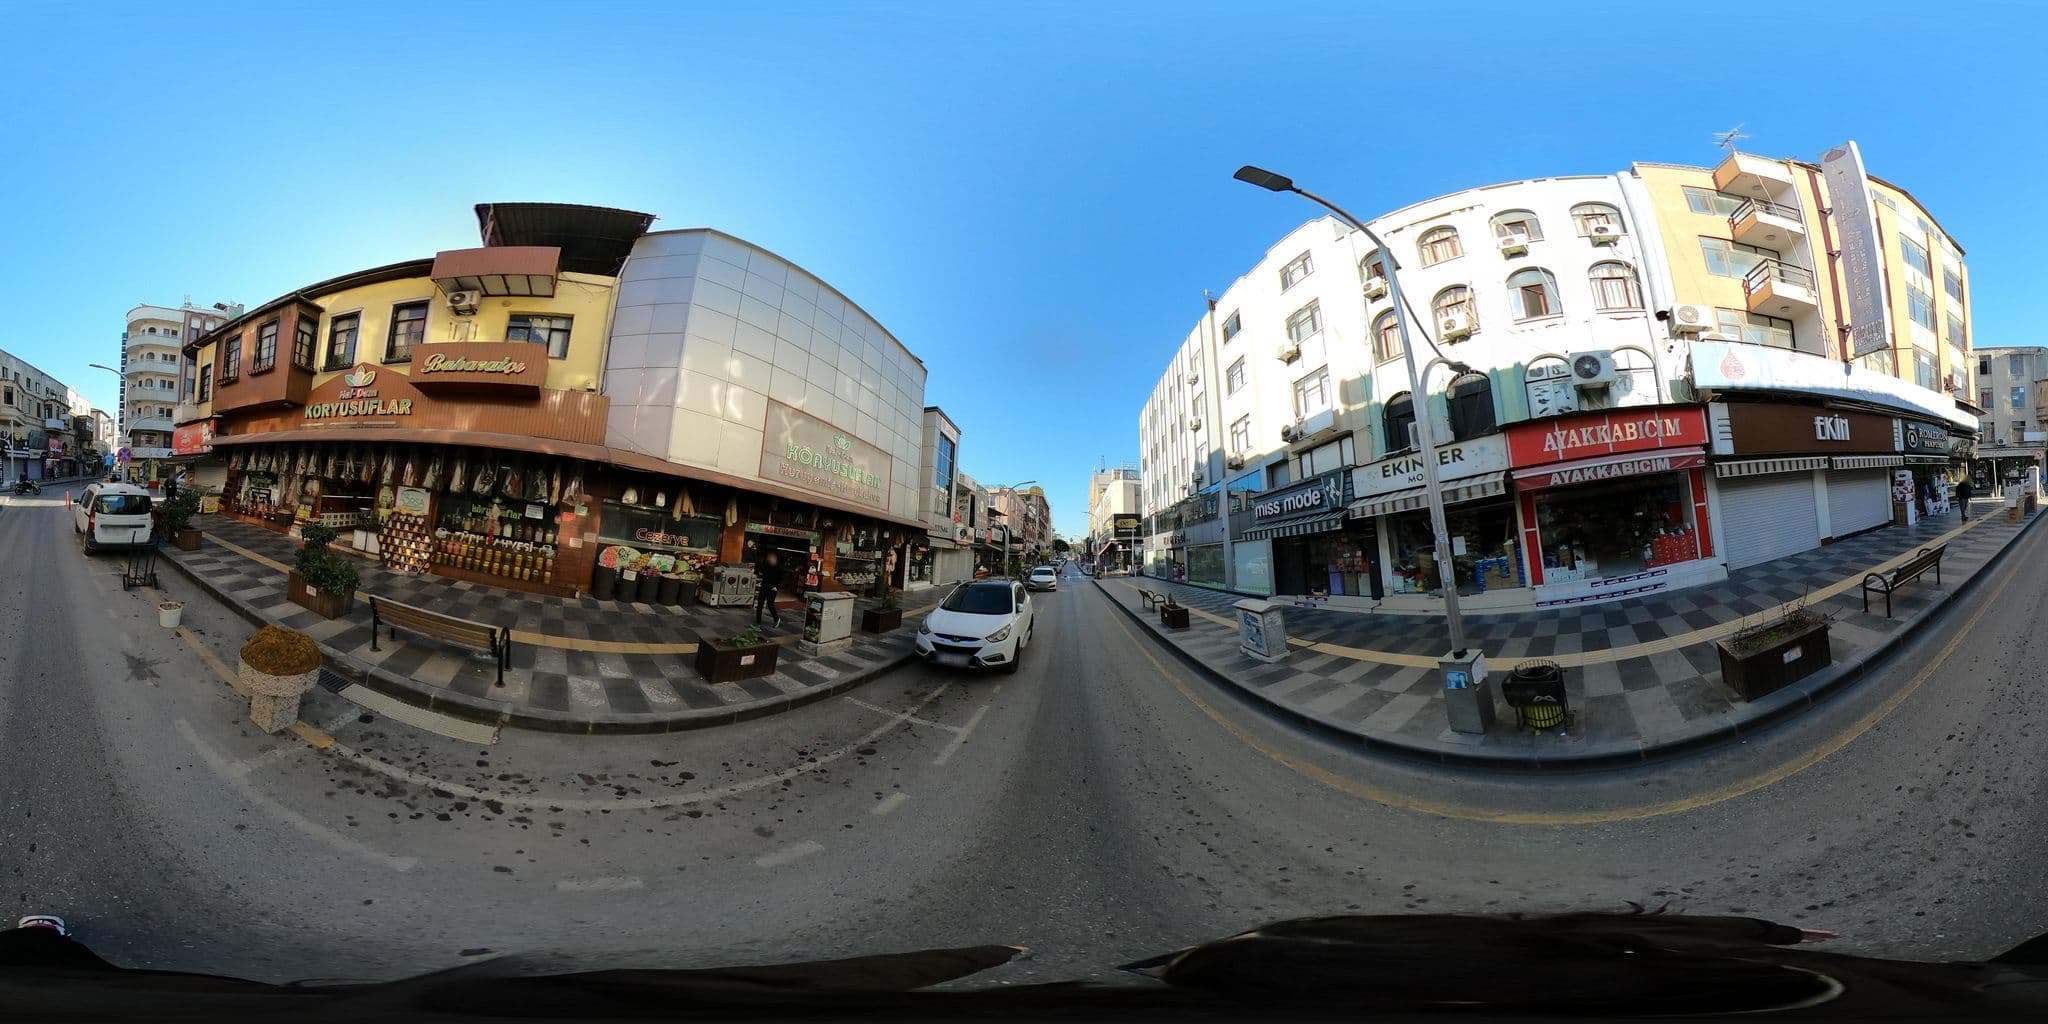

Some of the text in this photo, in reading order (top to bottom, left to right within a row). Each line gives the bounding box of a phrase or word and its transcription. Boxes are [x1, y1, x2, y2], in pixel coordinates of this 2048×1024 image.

[1543, 417, 1682, 452] AYAKKABICIM
[1381, 447, 1465, 479] EKİNER
[1255, 488, 1322, 519] miss mode
[635, 527, 690, 547] Cezerye
